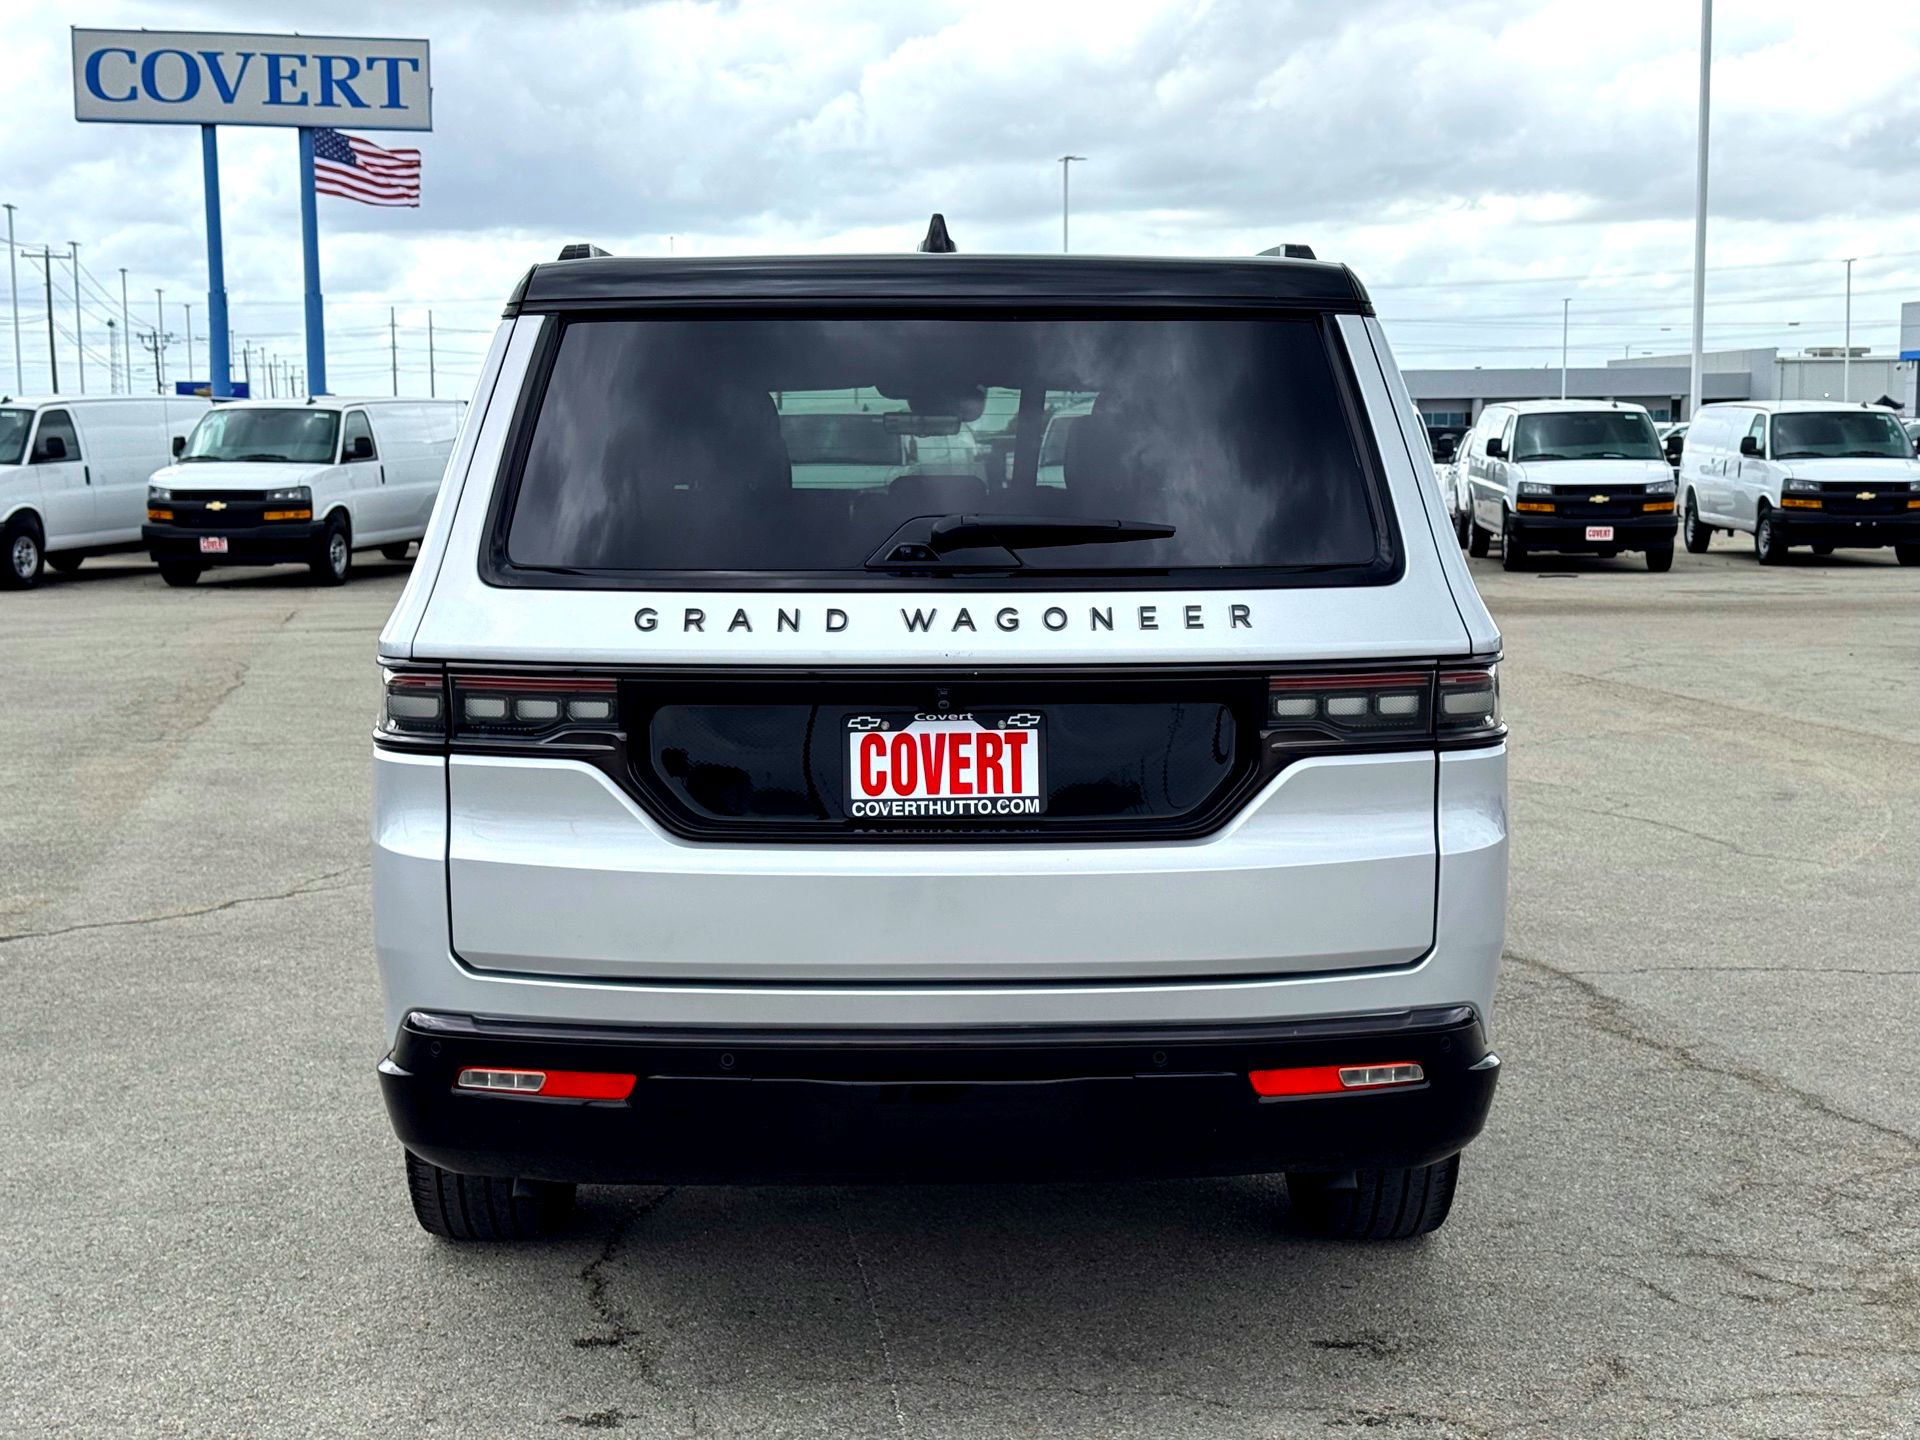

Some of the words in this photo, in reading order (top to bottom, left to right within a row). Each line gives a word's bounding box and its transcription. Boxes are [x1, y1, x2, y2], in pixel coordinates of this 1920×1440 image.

[85, 47, 419, 109] COVERT
[634, 607, 849, 632] GRAND
[900, 604, 1253, 632] WAGONEER
[914, 712, 974, 721] Covert
[860, 732, 1028, 796] COVERT
[851, 799, 1040, 817] COVERTHUTTO.COM
